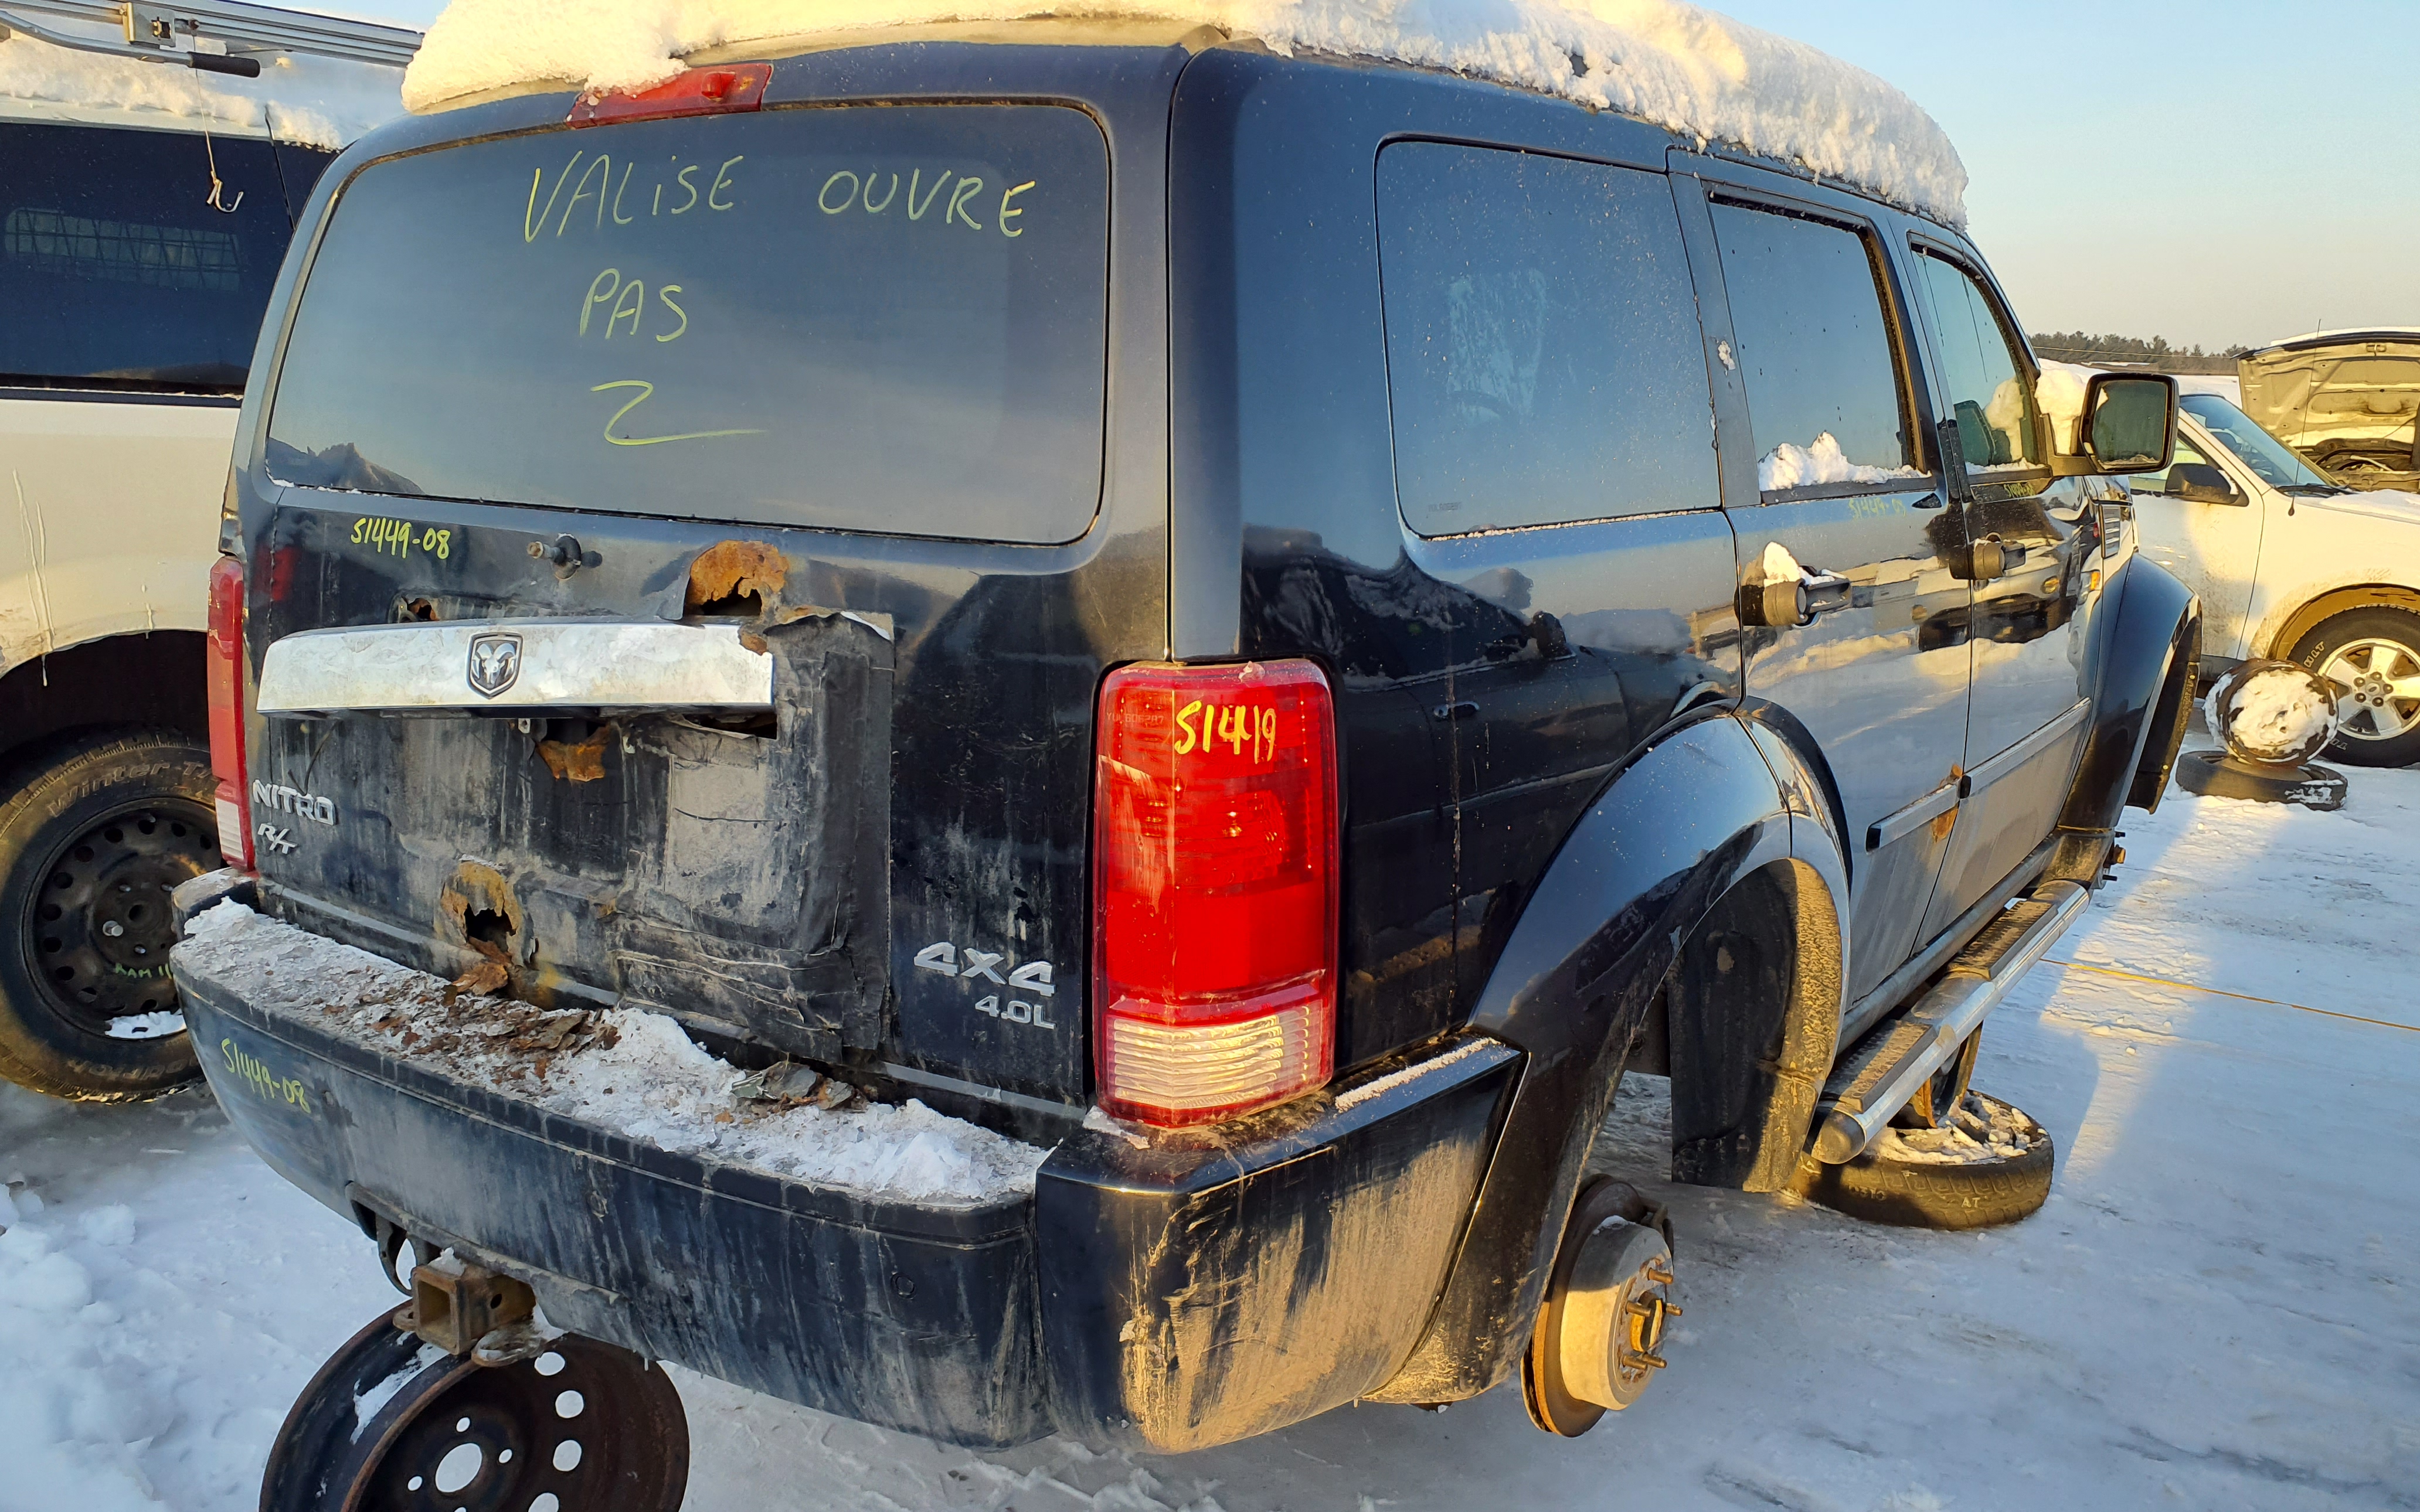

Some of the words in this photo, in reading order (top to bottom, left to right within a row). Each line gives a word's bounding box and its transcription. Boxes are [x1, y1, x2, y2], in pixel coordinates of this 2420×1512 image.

[818, 168, 1036, 237] OUVRE
[579, 267, 688, 342] PAS
[350, 517, 451, 559] S1449-08
[46, 762, 170, 818] Winter
[252, 778, 337, 826] NITRO
[257, 823, 297, 854] R/T
[115, 962, 152, 979] RAM
[974, 995, 1055, 1030] 4.0L
